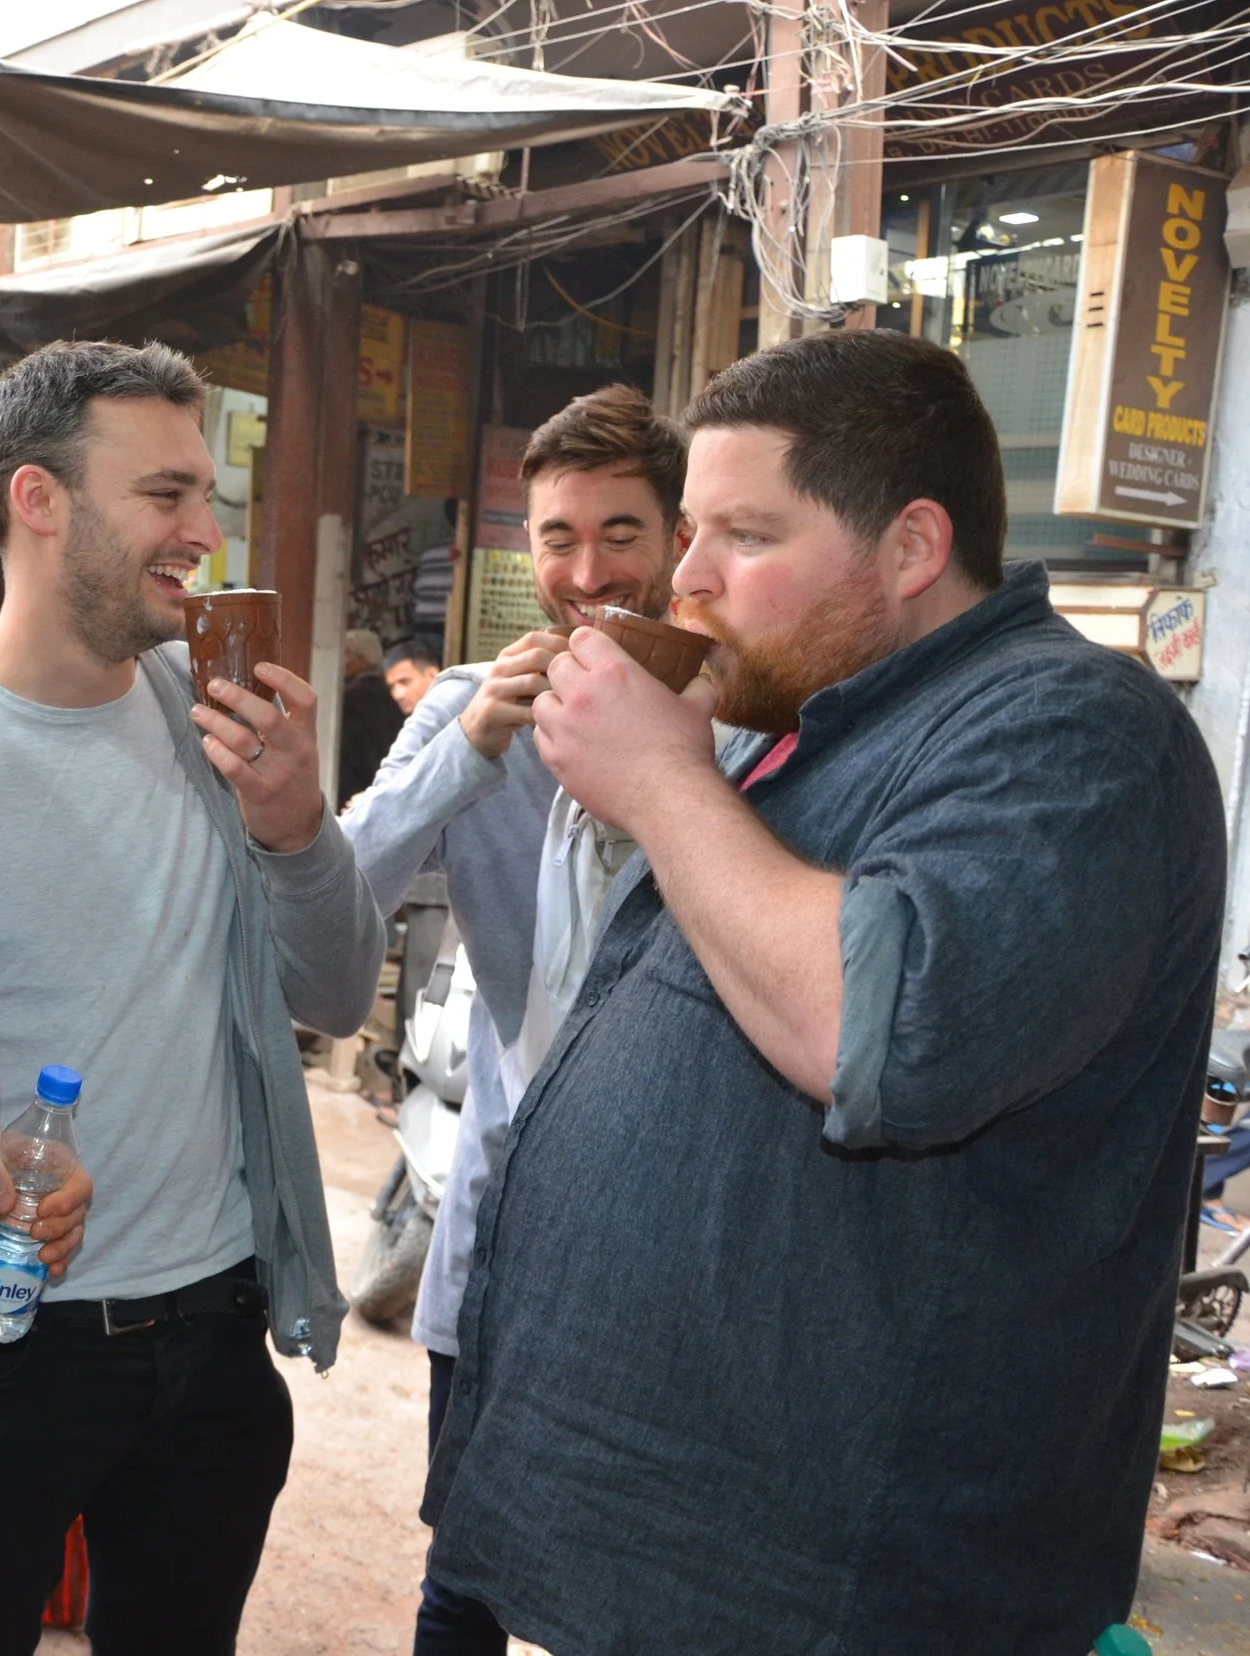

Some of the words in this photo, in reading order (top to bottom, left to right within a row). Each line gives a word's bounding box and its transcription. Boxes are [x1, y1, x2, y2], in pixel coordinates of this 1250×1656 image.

[1147, 182, 1206, 410] NOVELTY
[1114, 405, 1146, 437] CARD
[1147, 411, 1206, 447] PRODUCTS
[1110, 459, 1163, 486] WEDDING
[1164, 469, 1200, 491] CARDS
